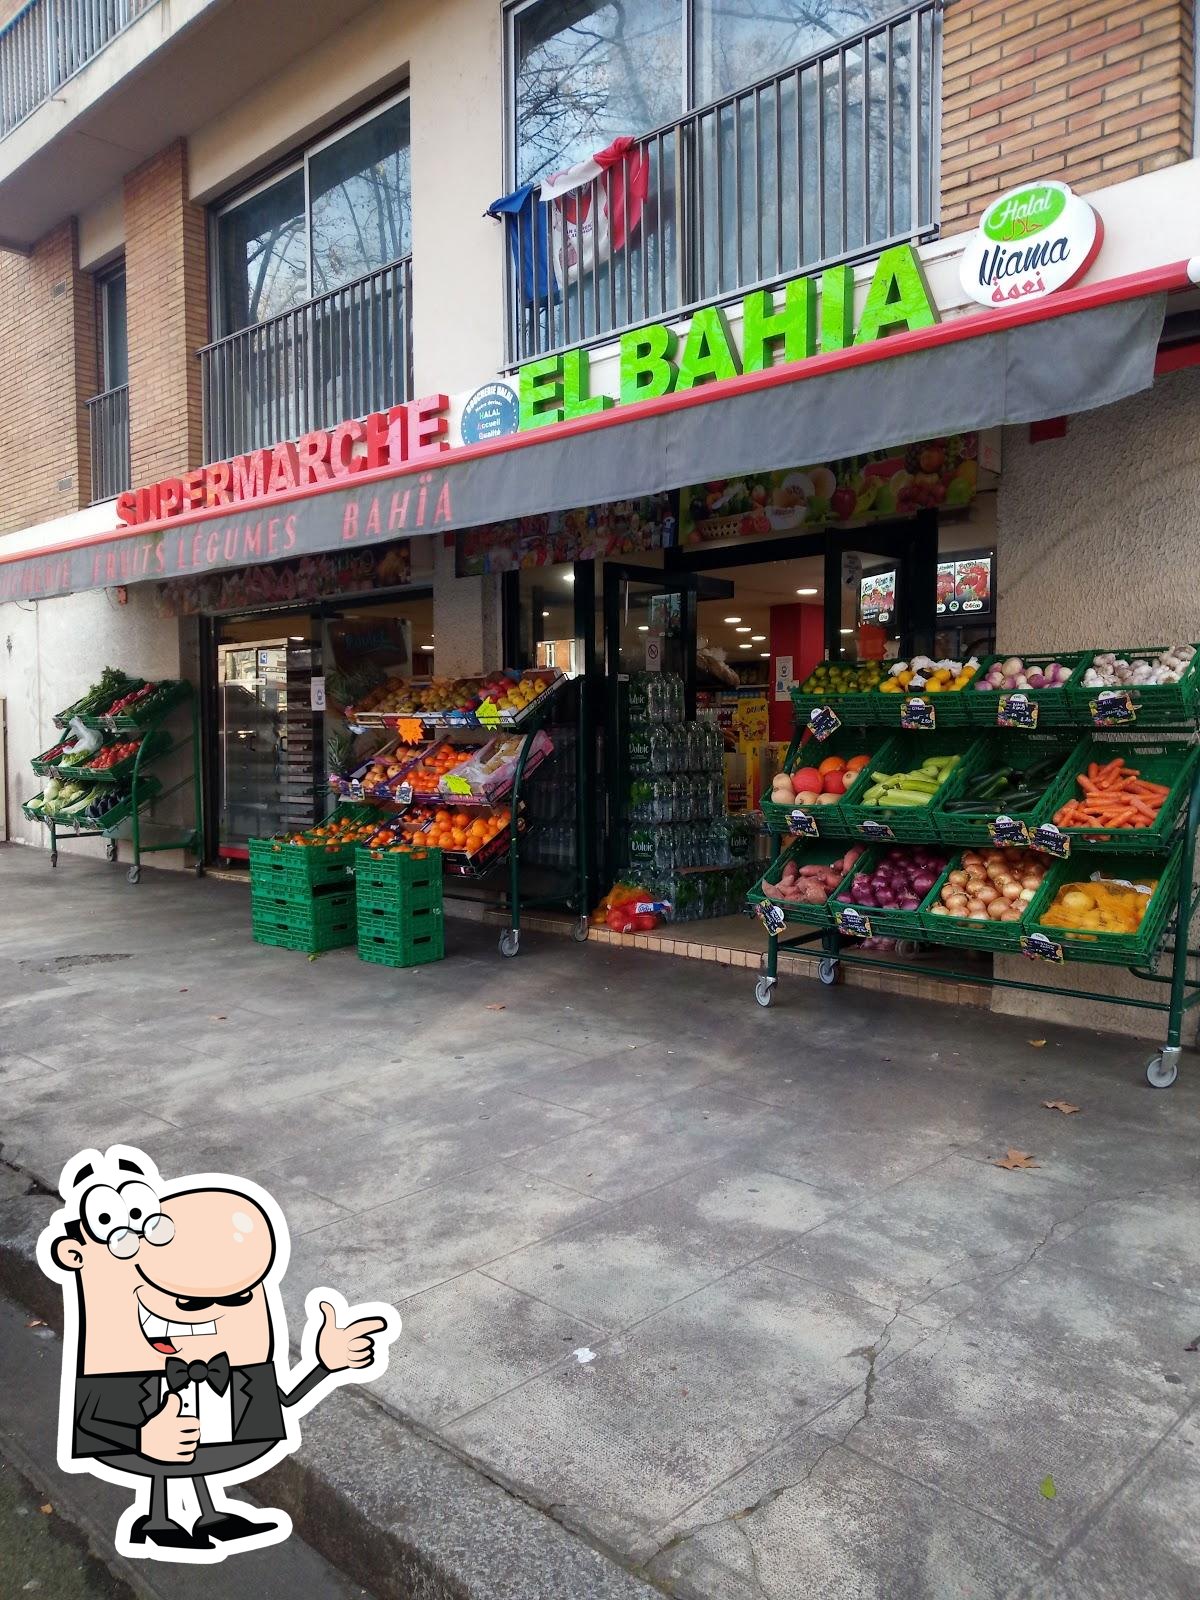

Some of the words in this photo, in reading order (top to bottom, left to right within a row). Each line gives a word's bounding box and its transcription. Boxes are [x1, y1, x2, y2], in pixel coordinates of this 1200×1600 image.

[988, 189, 1052, 229] Halal
[519, 347, 614, 432] EL
[620, 244, 941, 405] BAHIA
[479, 408, 501, 420] HALAL
[115, 394, 450, 529] SUPERMARCHE
[93, 537, 167, 586] FRUITS
[341, 473, 453, 541] BAHÏA
[631, 840, 654, 853] Volvic
